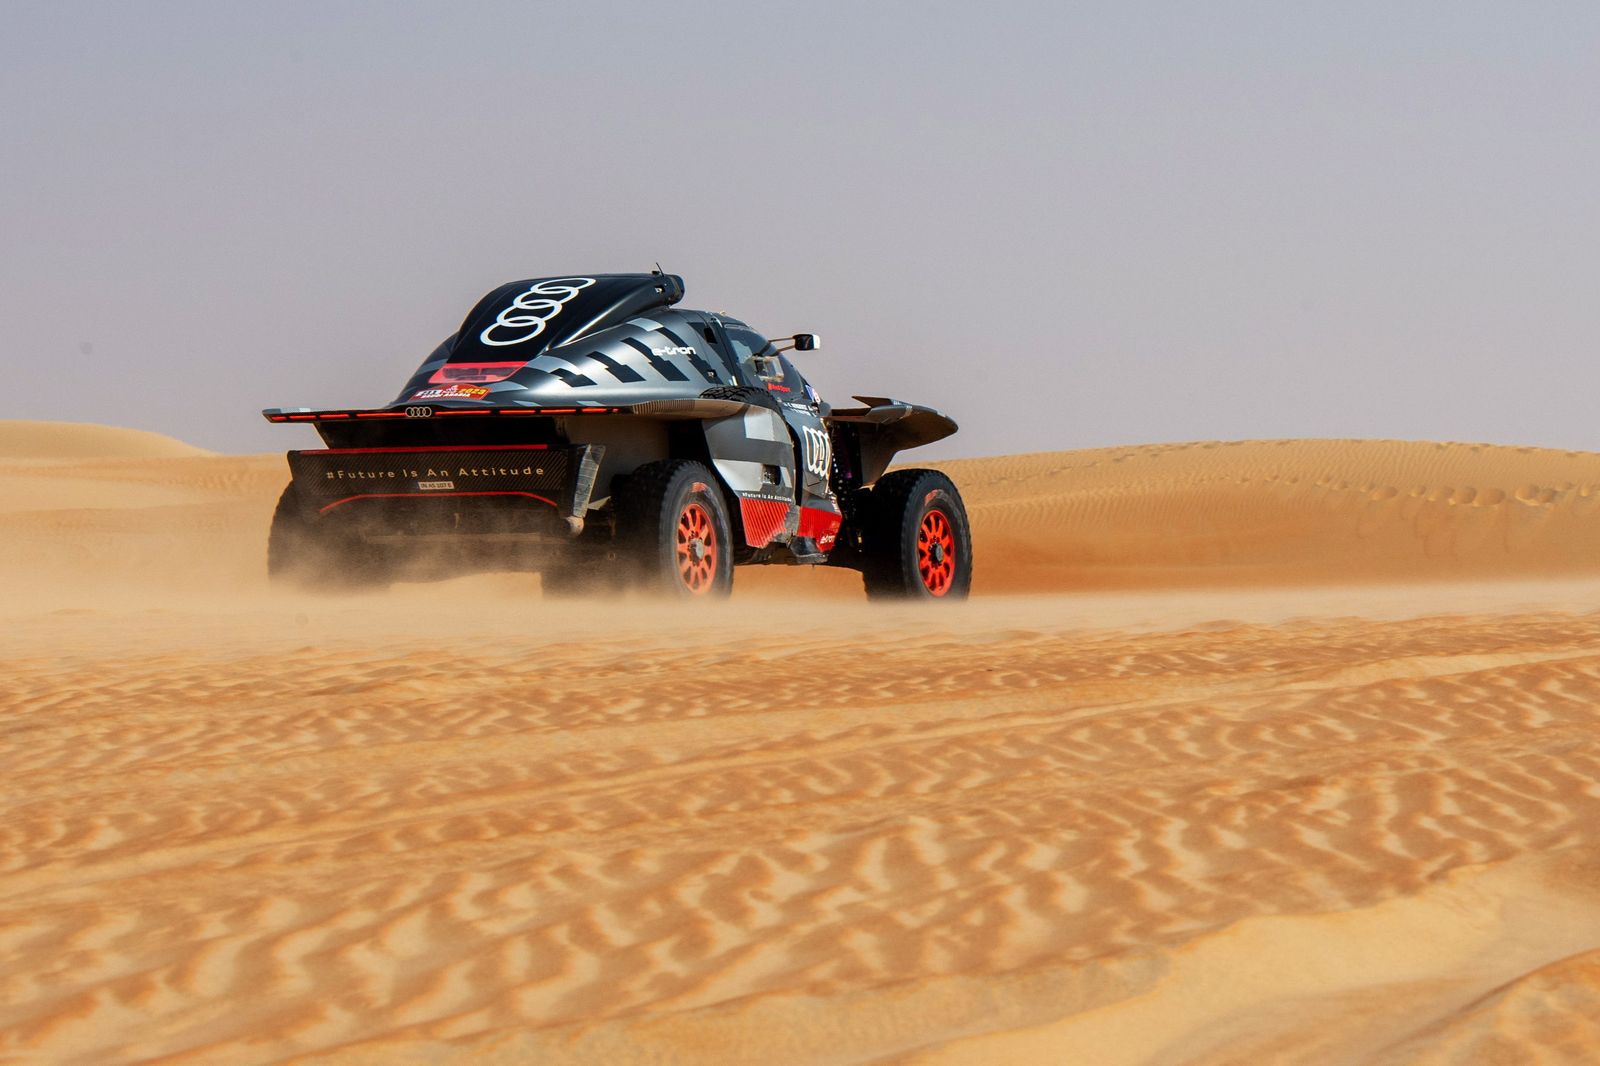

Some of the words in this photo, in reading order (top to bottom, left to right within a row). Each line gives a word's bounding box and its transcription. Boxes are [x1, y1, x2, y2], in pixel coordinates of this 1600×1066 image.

[651, 346, 697, 356] e-tron
[326, 470, 395, 480] #Future
[403, 468, 418, 478] Is
[427, 468, 449, 477] An
[458, 466, 545, 477] Attitude
